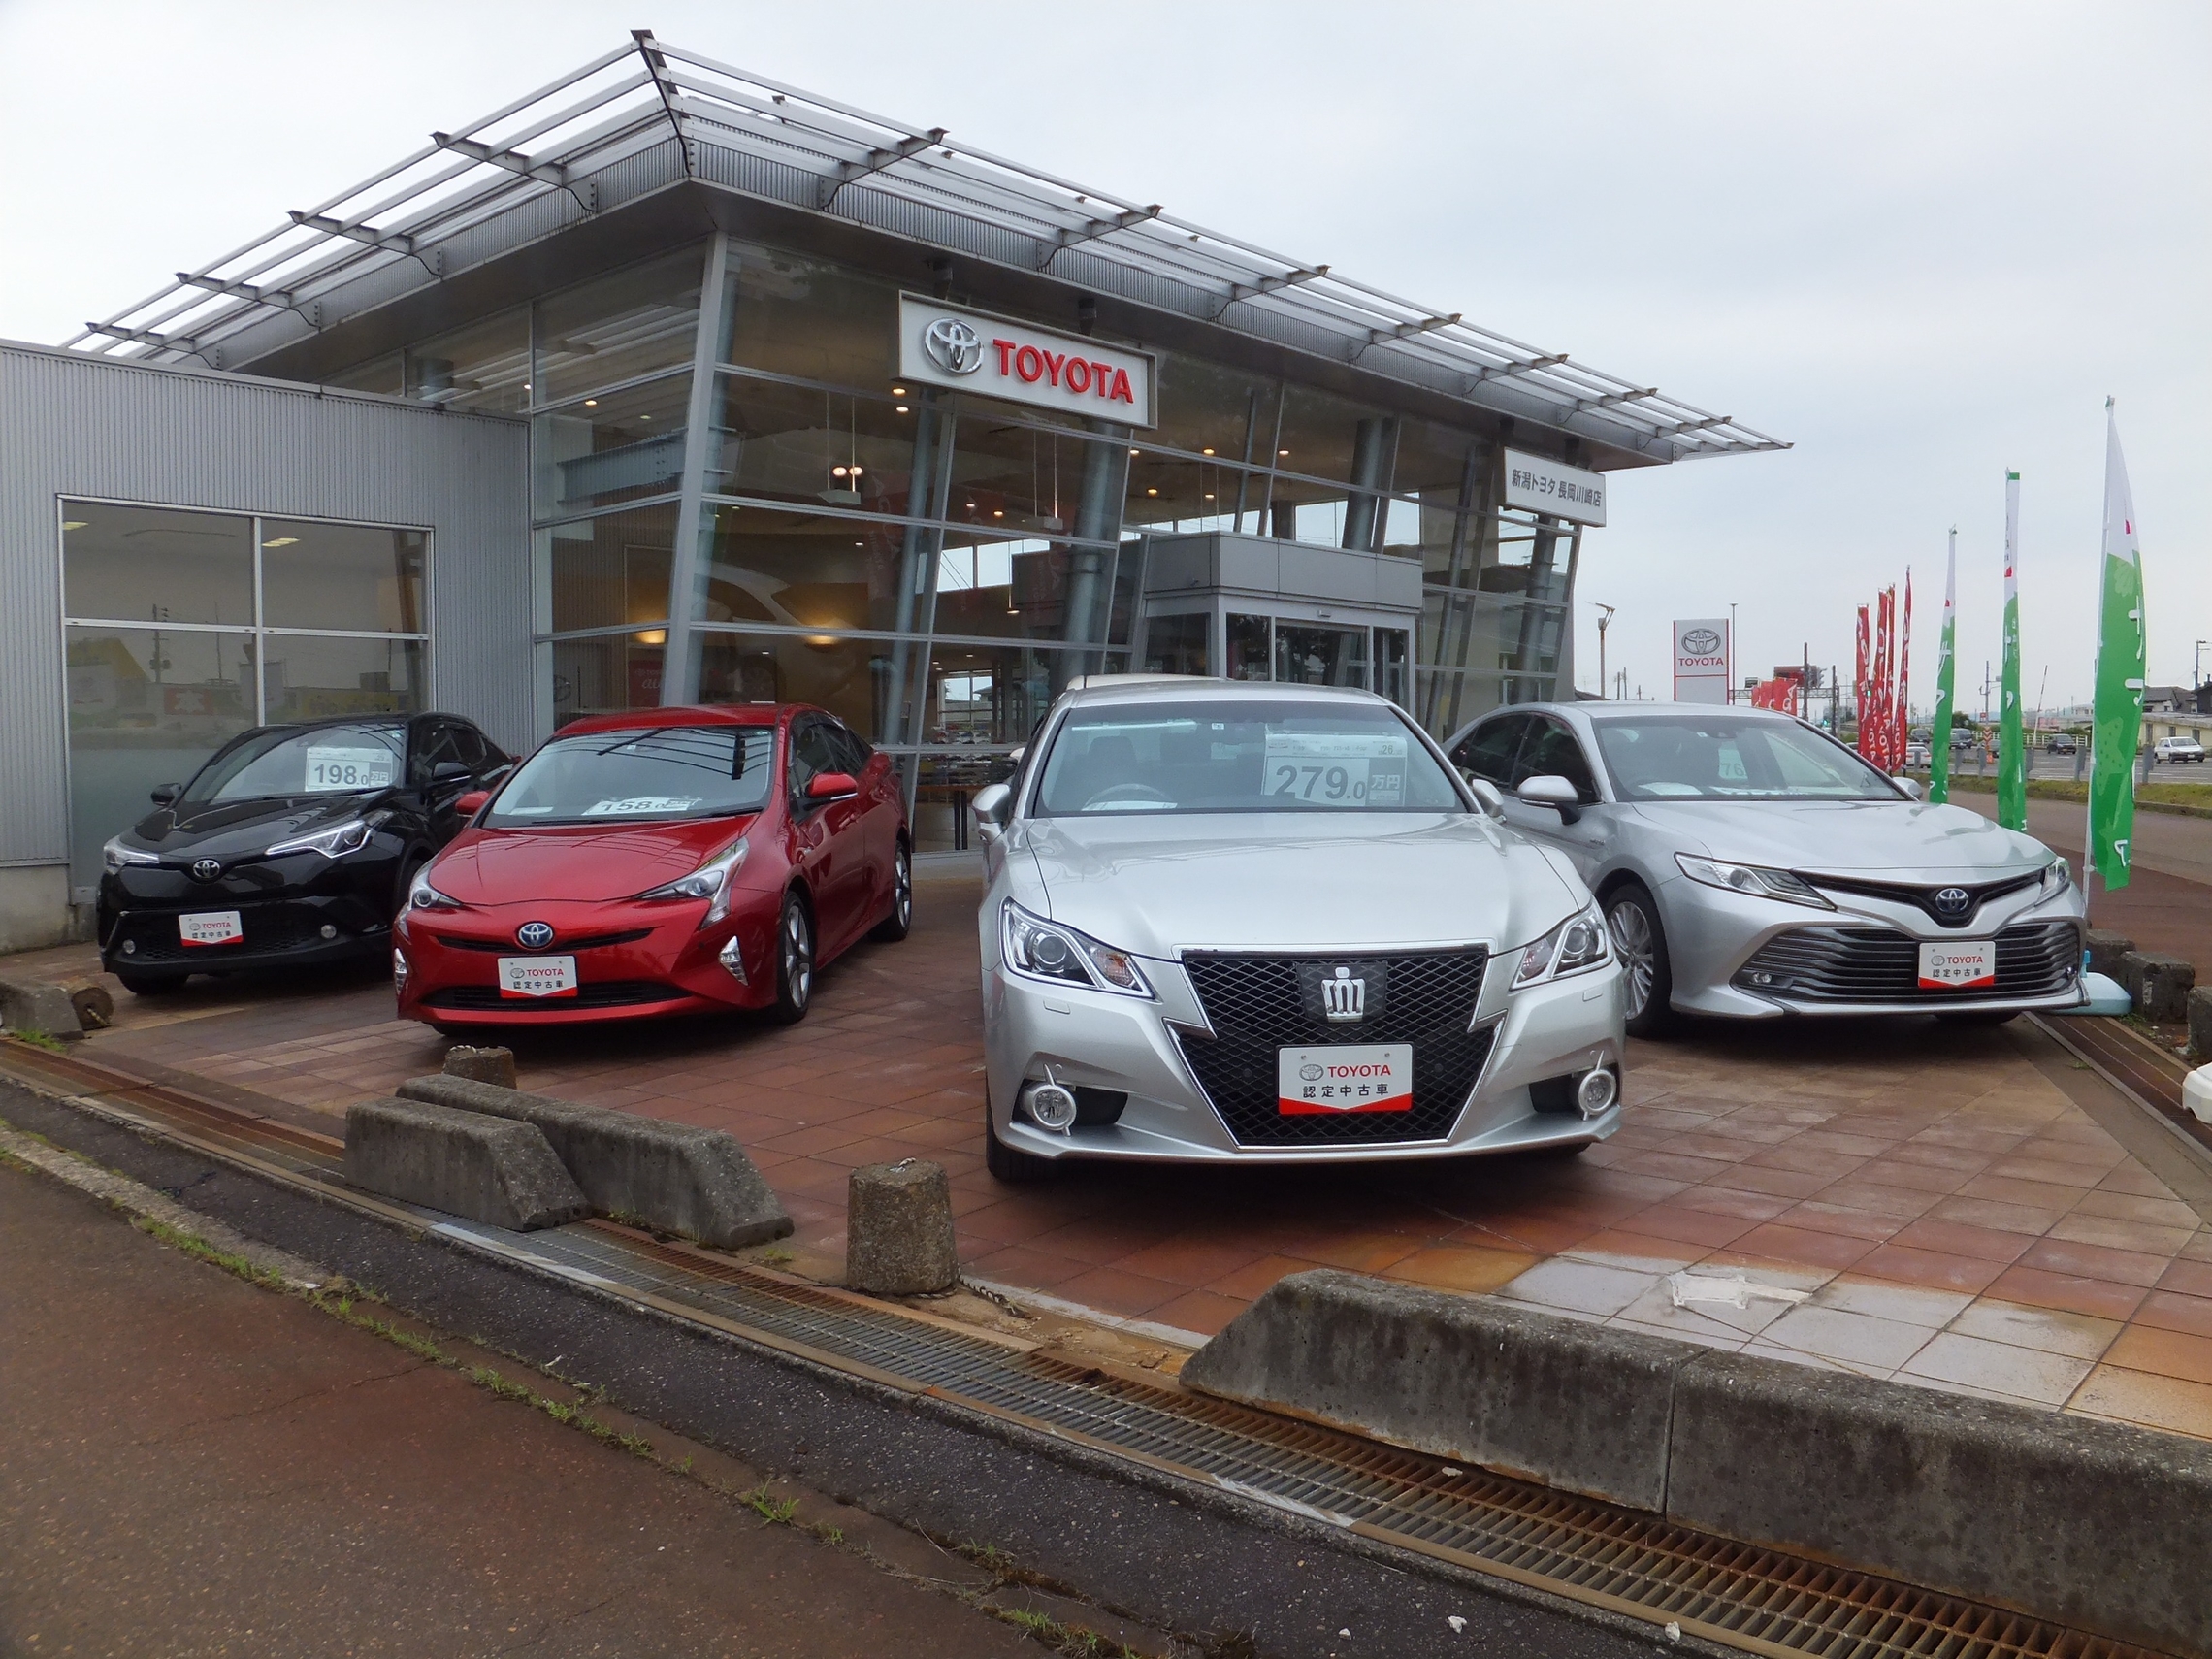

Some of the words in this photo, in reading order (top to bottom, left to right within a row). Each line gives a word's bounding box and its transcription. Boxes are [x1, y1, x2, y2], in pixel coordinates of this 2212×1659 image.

[992, 338, 1134, 404] TOYOTA
[1512, 468, 1556, 495] 新潟トヨタ
[1557, 480, 1602, 507] 長岡川崎店
[1678, 657, 1724, 667] TOYOTA
[1371, 774, 1401, 790] 万円
[1946, 956, 1984, 964] TOYOTA
[526, 968, 565, 977] TOYOTA
[1327, 1064, 1392, 1078] TOYOTA
[1302, 1083, 1389, 1098] 認定中古車
